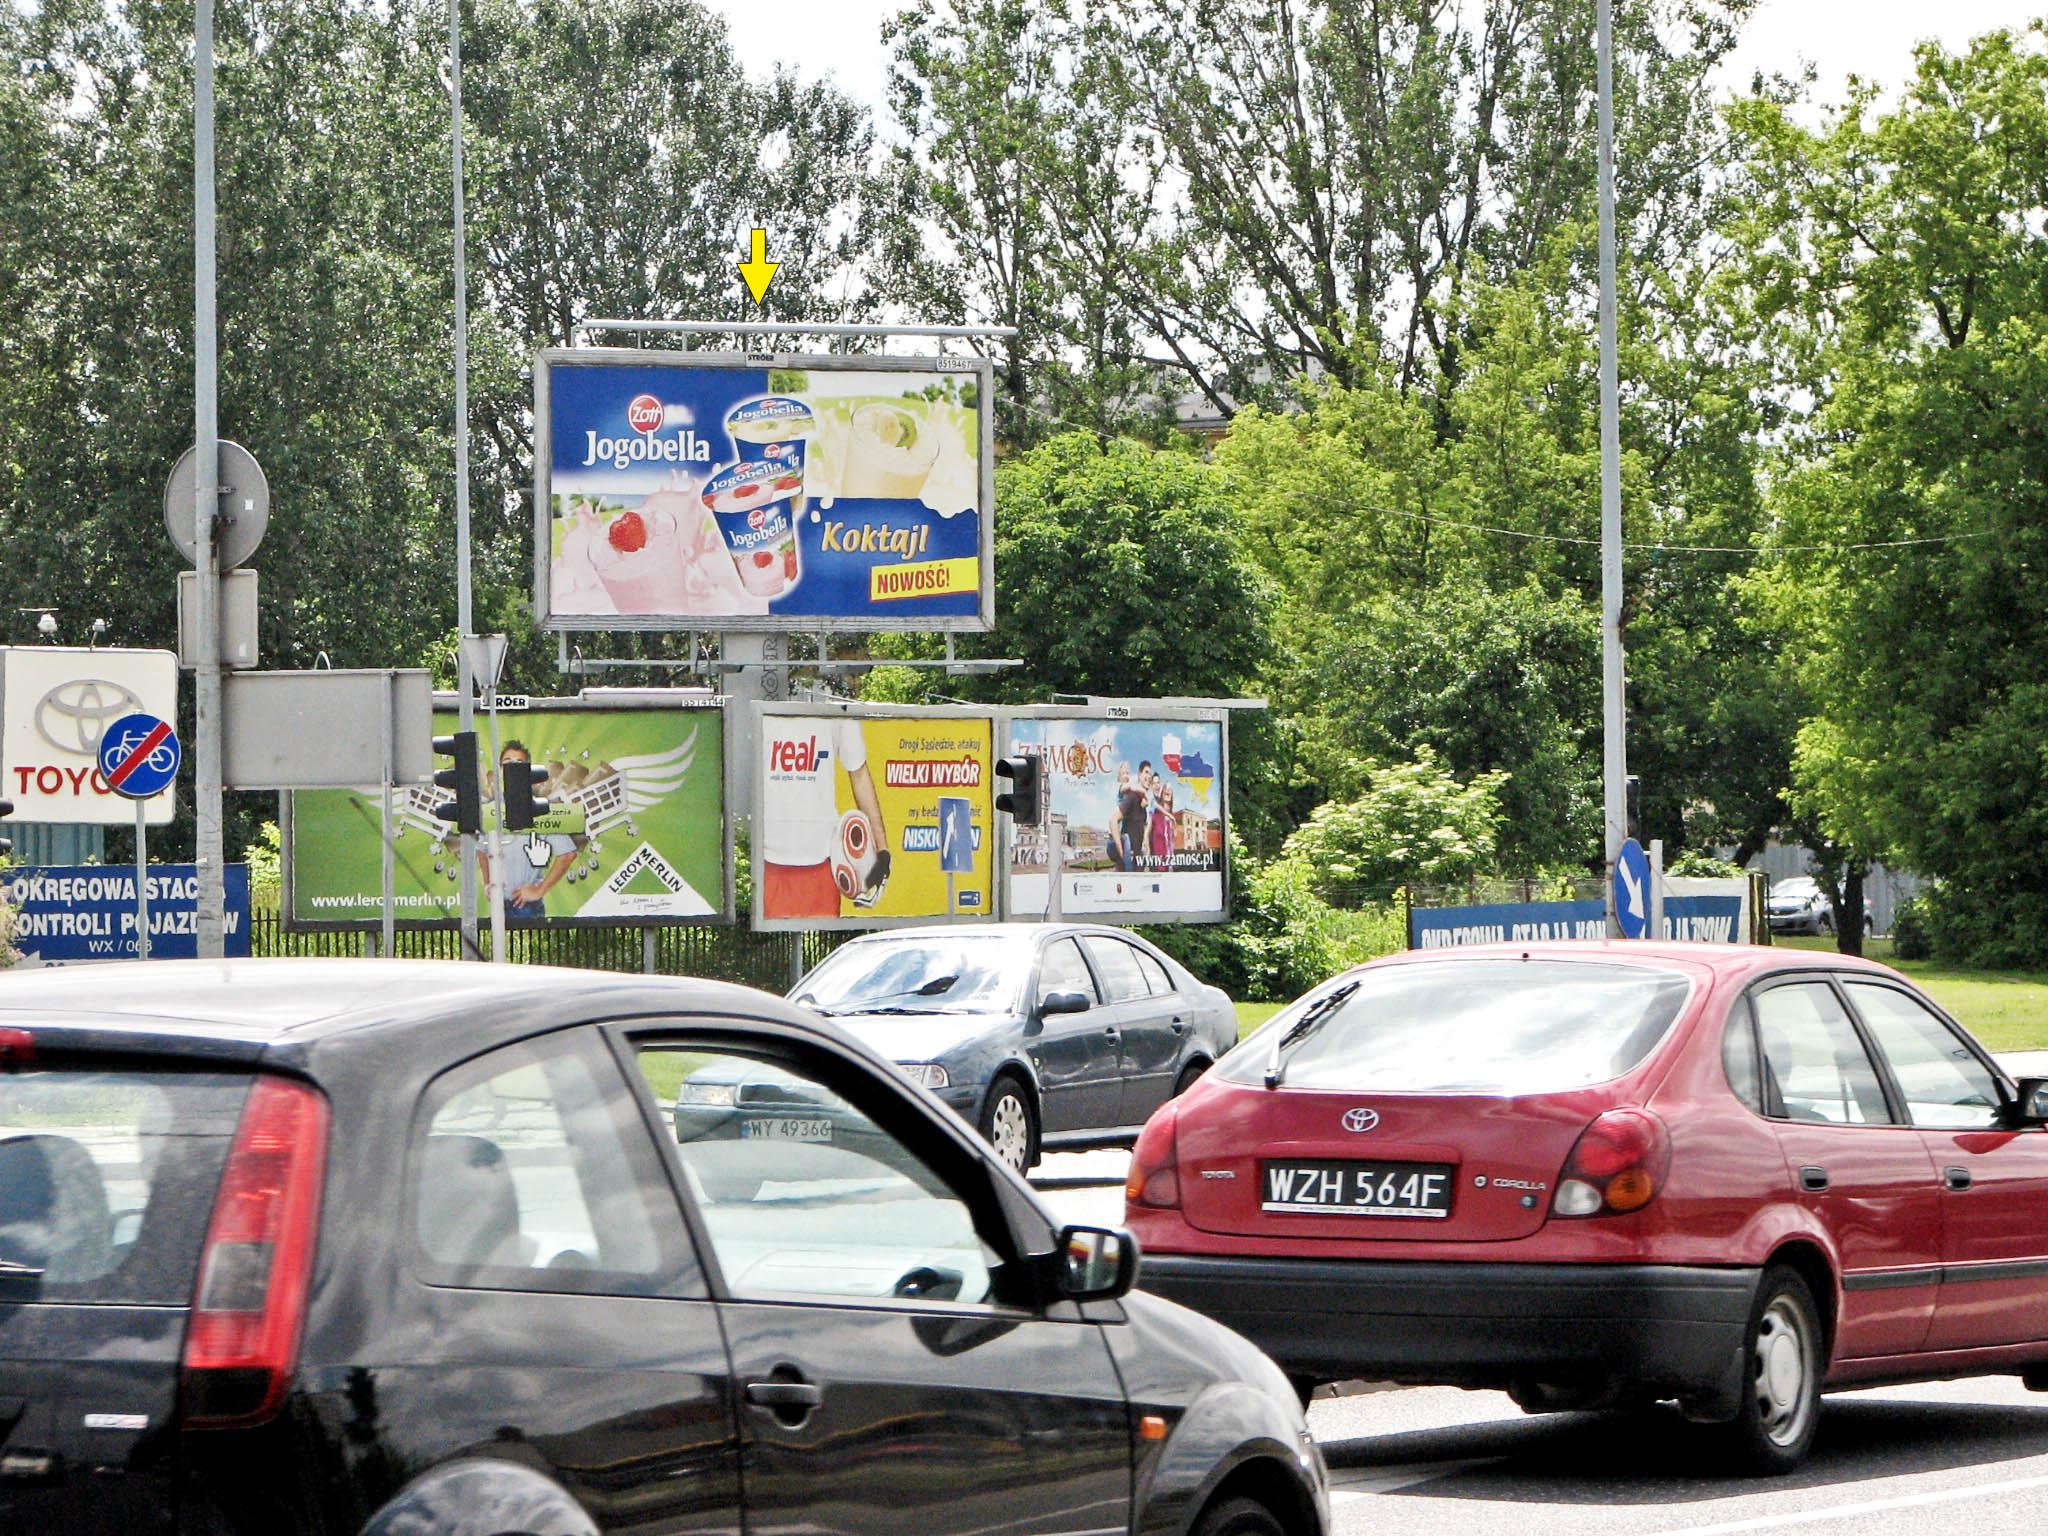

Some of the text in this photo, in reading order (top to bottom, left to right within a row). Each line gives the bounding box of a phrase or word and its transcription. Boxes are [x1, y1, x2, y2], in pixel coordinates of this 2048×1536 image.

[735, 404, 804, 421] Jogobella
[583, 428, 711, 469] Jogobella
[711, 462, 784, 492] Jogobella
[729, 515, 788, 548] Jogobella
[821, 520, 930, 560] Koktajl
[876, 564, 952, 594] NOWOŚĆ!
[887, 758, 979, 784] WIELKI WYBÓR
[608, 856, 643, 893] LEROY
[639, 848, 684, 892] MERLIN
[13, 877, 136, 907] OKRĘGOWA
[311, 892, 461, 909] www.leromerlin.pl
[17, 912, 112, 936] ONTROLI
[88, 940, 114, 953] WX
[751, 1120, 773, 1137] WY
[1269, 1168, 1446, 1207] WZH 564F
